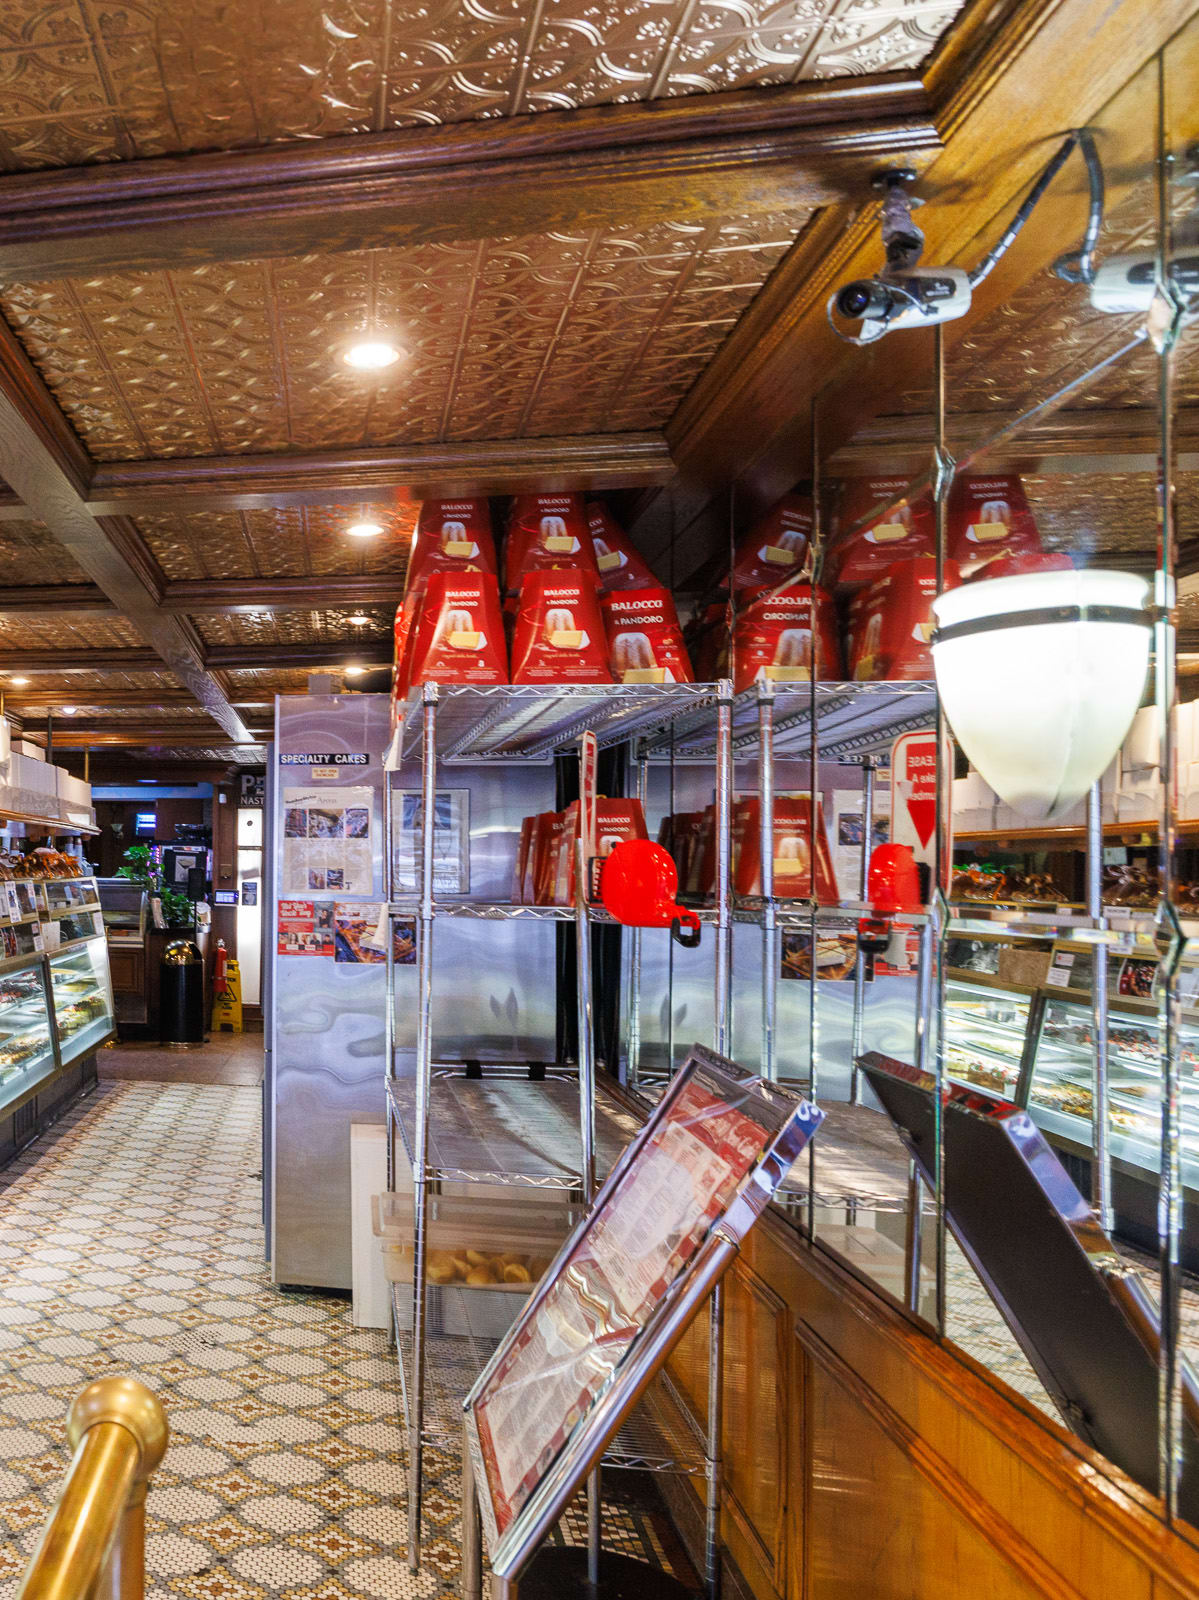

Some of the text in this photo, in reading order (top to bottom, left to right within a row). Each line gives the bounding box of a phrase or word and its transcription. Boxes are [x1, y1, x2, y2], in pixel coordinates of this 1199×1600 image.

[611, 600, 664, 611] BALOCCO
[620, 615, 664, 625] PANDORO
[280, 754, 367, 764] SPECIALTY CAKES
